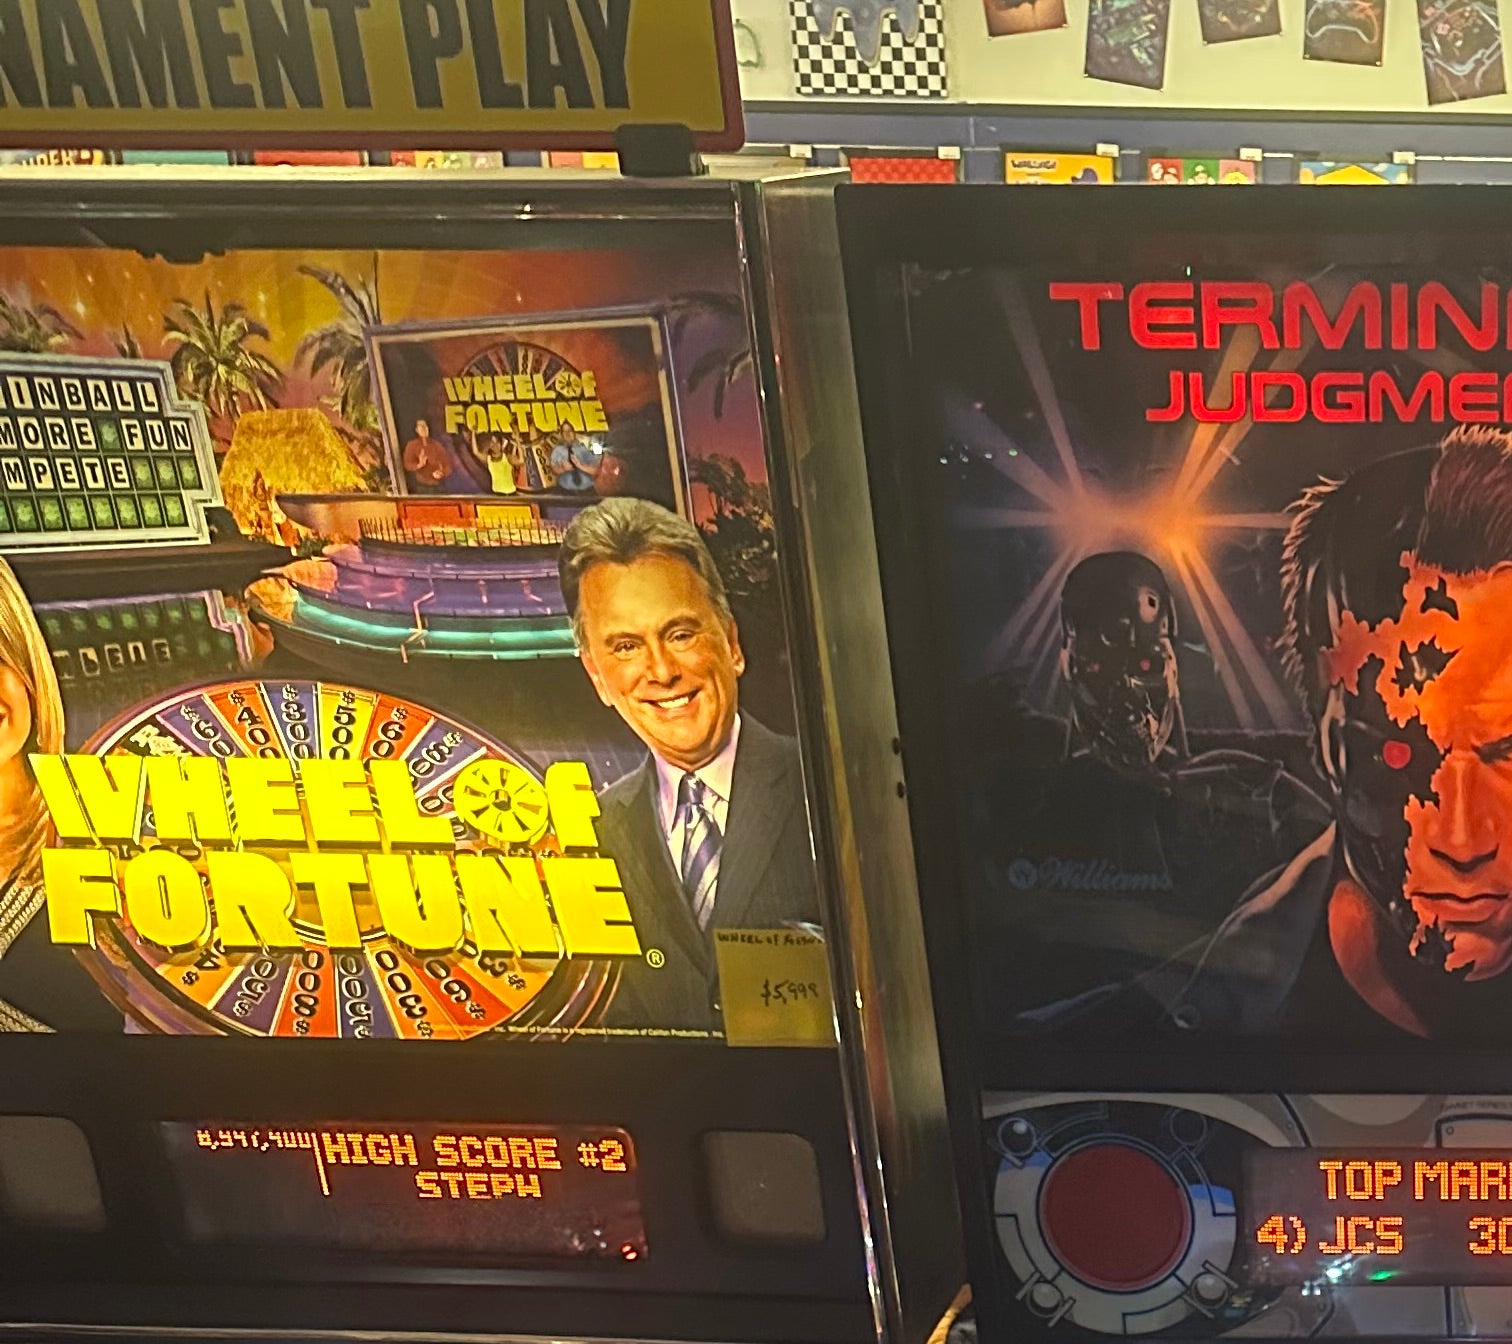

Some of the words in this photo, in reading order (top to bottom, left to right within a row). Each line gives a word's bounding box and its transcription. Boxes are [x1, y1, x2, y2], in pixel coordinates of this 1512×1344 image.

[402, 0, 636, 110] PLAY
[443, 376, 553, 403] WHEEL
[0, 421, 94, 447] MORE
[124, 423, 191, 449] FUN
[445, 401, 609, 433] FORTUNE
[29, 752, 455, 853] WHEEL
[43, 846, 644, 959] FORTUNE
[760, 978, 819, 1007] $5,999
[323, 1132, 418, 1166] HIGH
[433, 1135, 562, 1170] SCORE
[577, 1139, 627, 1172] #2
[1319, 1160, 1402, 1200] TOP
[1256, 1215, 1307, 1255] 4)
[1318, 1216, 1403, 1254] JCS
